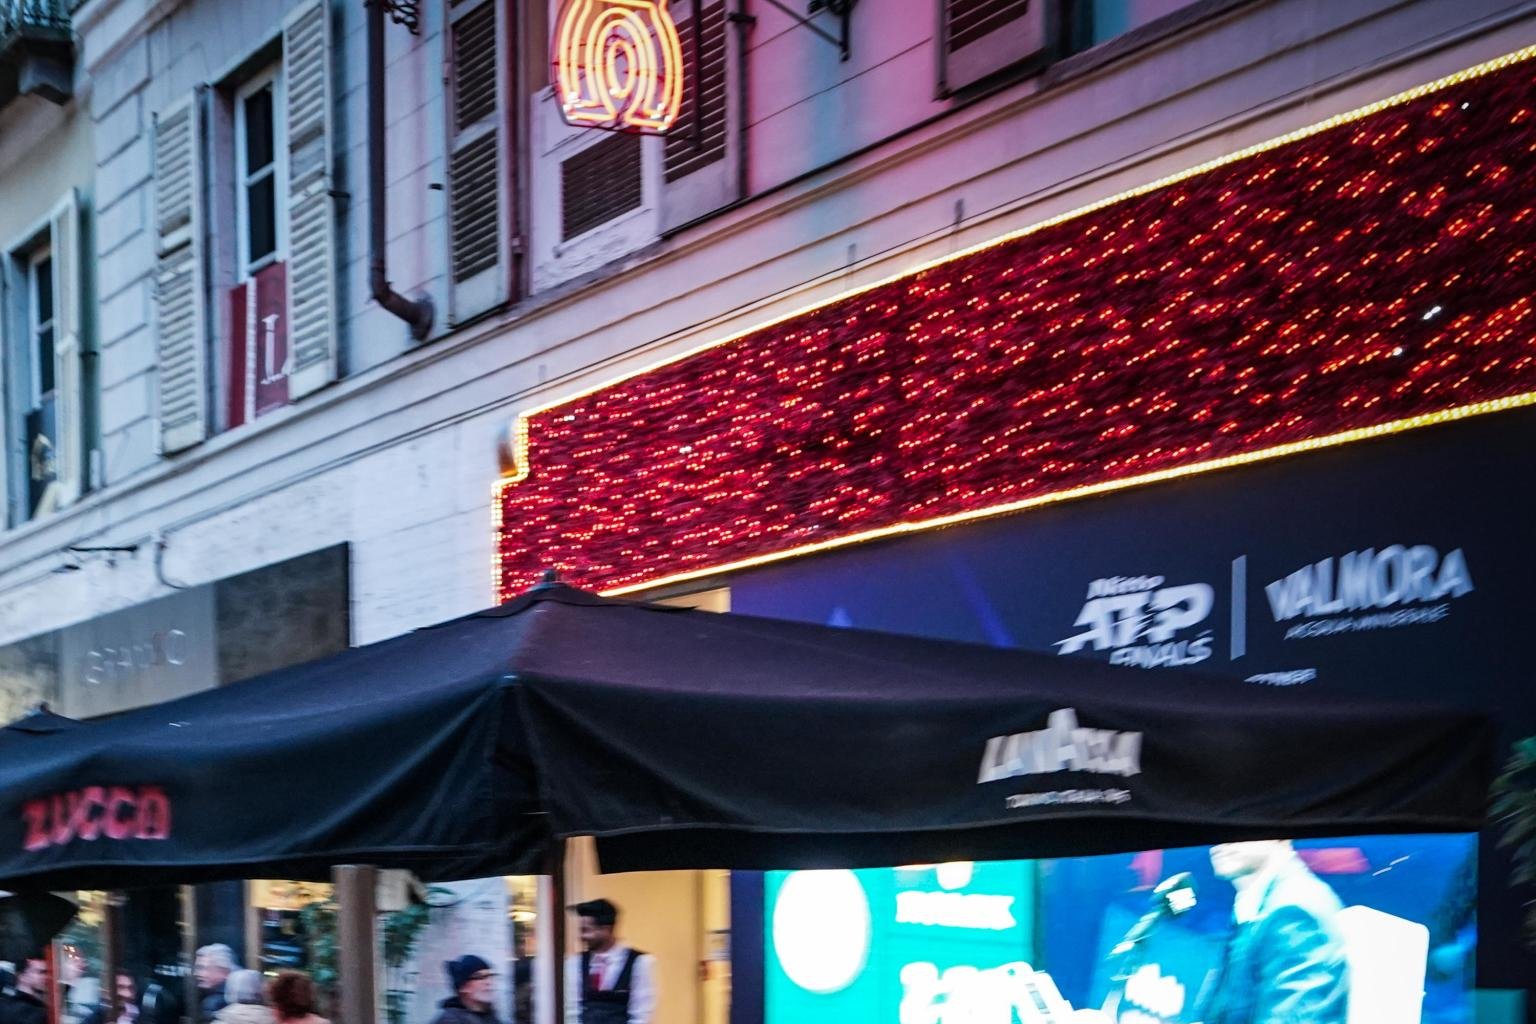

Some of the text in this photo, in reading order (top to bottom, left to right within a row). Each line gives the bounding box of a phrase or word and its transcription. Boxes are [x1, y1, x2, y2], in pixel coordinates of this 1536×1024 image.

[1050, 583, 1214, 655] ATP
[1265, 544, 1474, 622] VALMORA
[1109, 636, 1214, 669] FINALS
